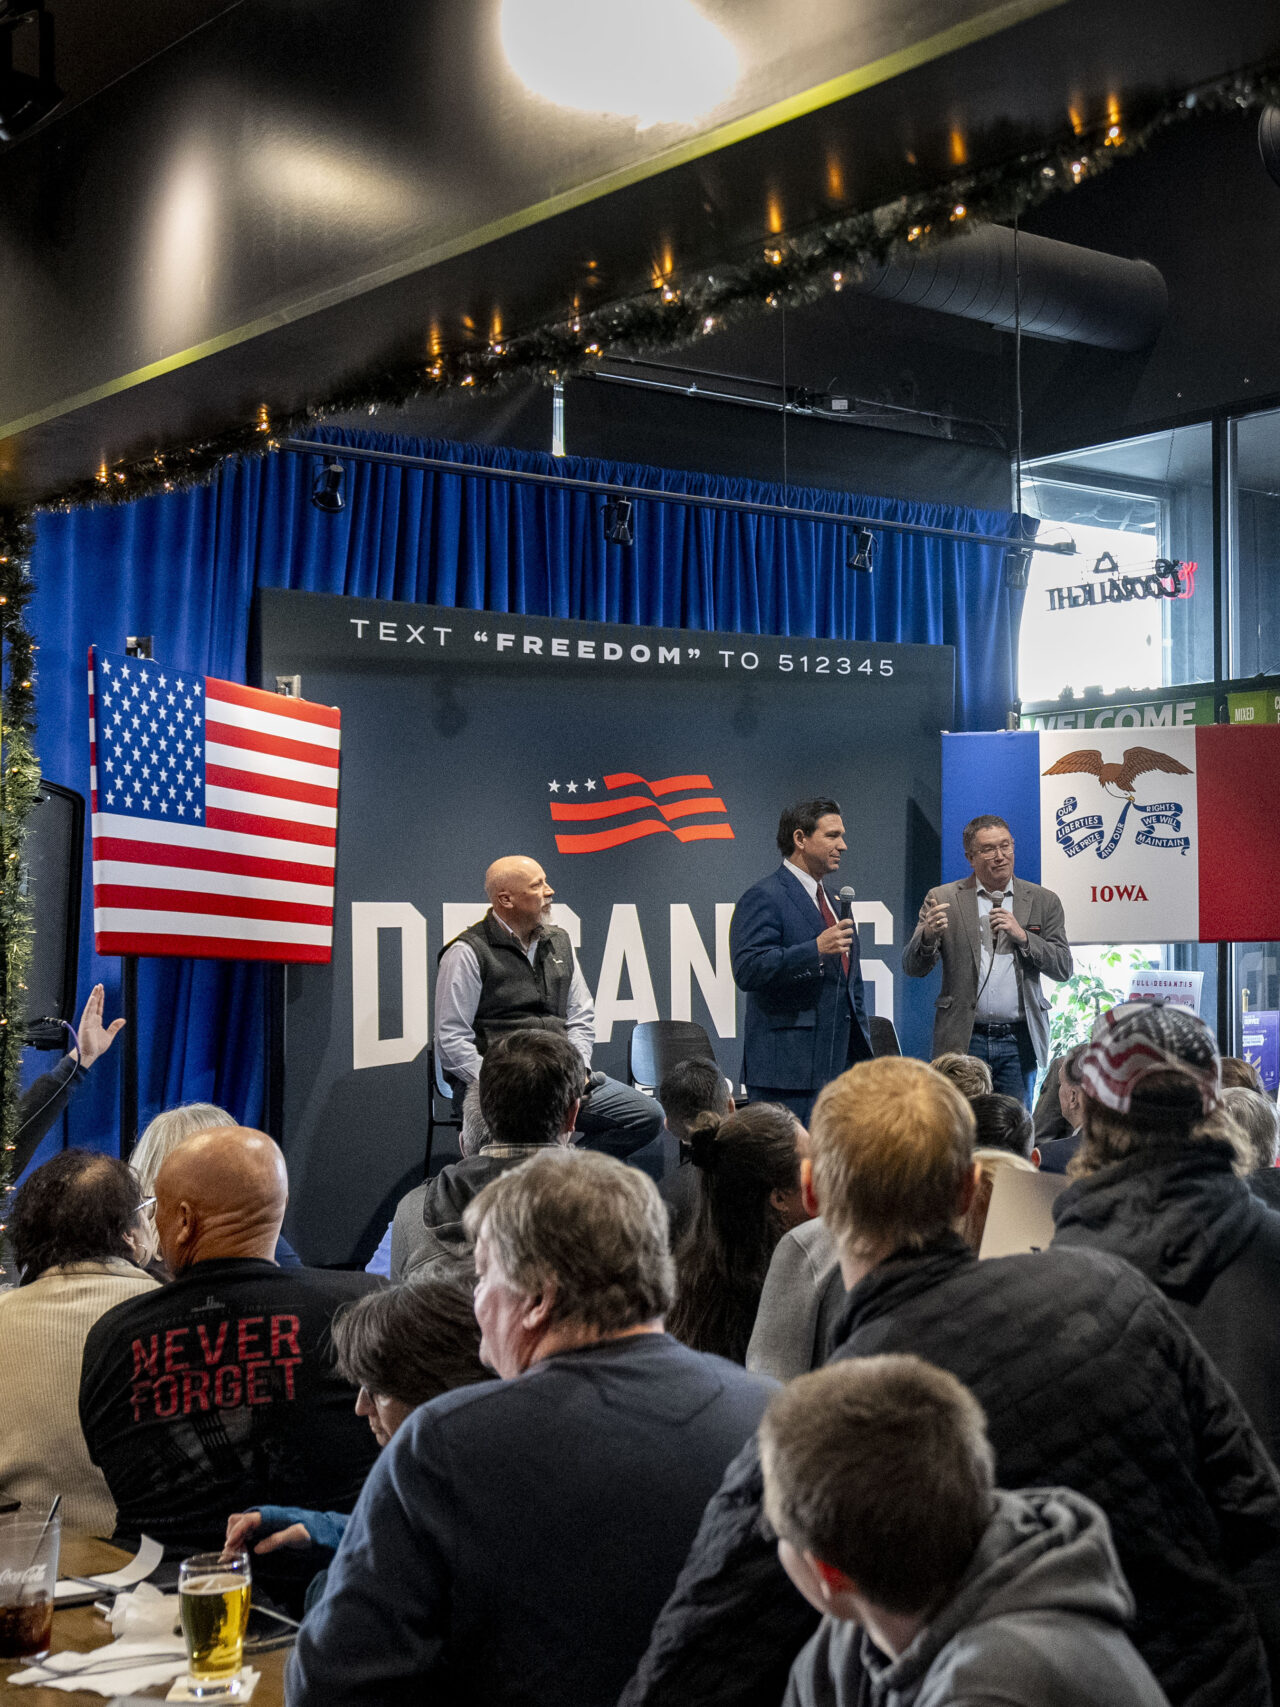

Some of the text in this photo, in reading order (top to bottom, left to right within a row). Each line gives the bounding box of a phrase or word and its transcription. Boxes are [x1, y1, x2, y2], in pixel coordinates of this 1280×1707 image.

[350, 619, 452, 646] TEXT
[719, 650, 759, 670] TO
[778, 654, 894, 677] 512345
[1022, 702, 1196, 730] WELCOME
[1235, 707, 1254, 721] MIXED
[1058, 805, 1073, 817] OUR
[1146, 803, 1175, 812] RIGHTS
[1057, 816, 1099, 837] LIBERTIES
[1143, 815, 1177, 826] WE WILL
[1066, 832, 1101, 857] WE PRIZE
[1101, 823, 1124, 858] AND OUR
[1137, 834, 1185, 847] MAINTAIN
[1090, 885, 1149, 902] IOWA
[1153, 980, 1193, 988] DESANTIS
[131, 1314, 302, 1378] NEVER
[129, 1357, 302, 1422] FORGET
